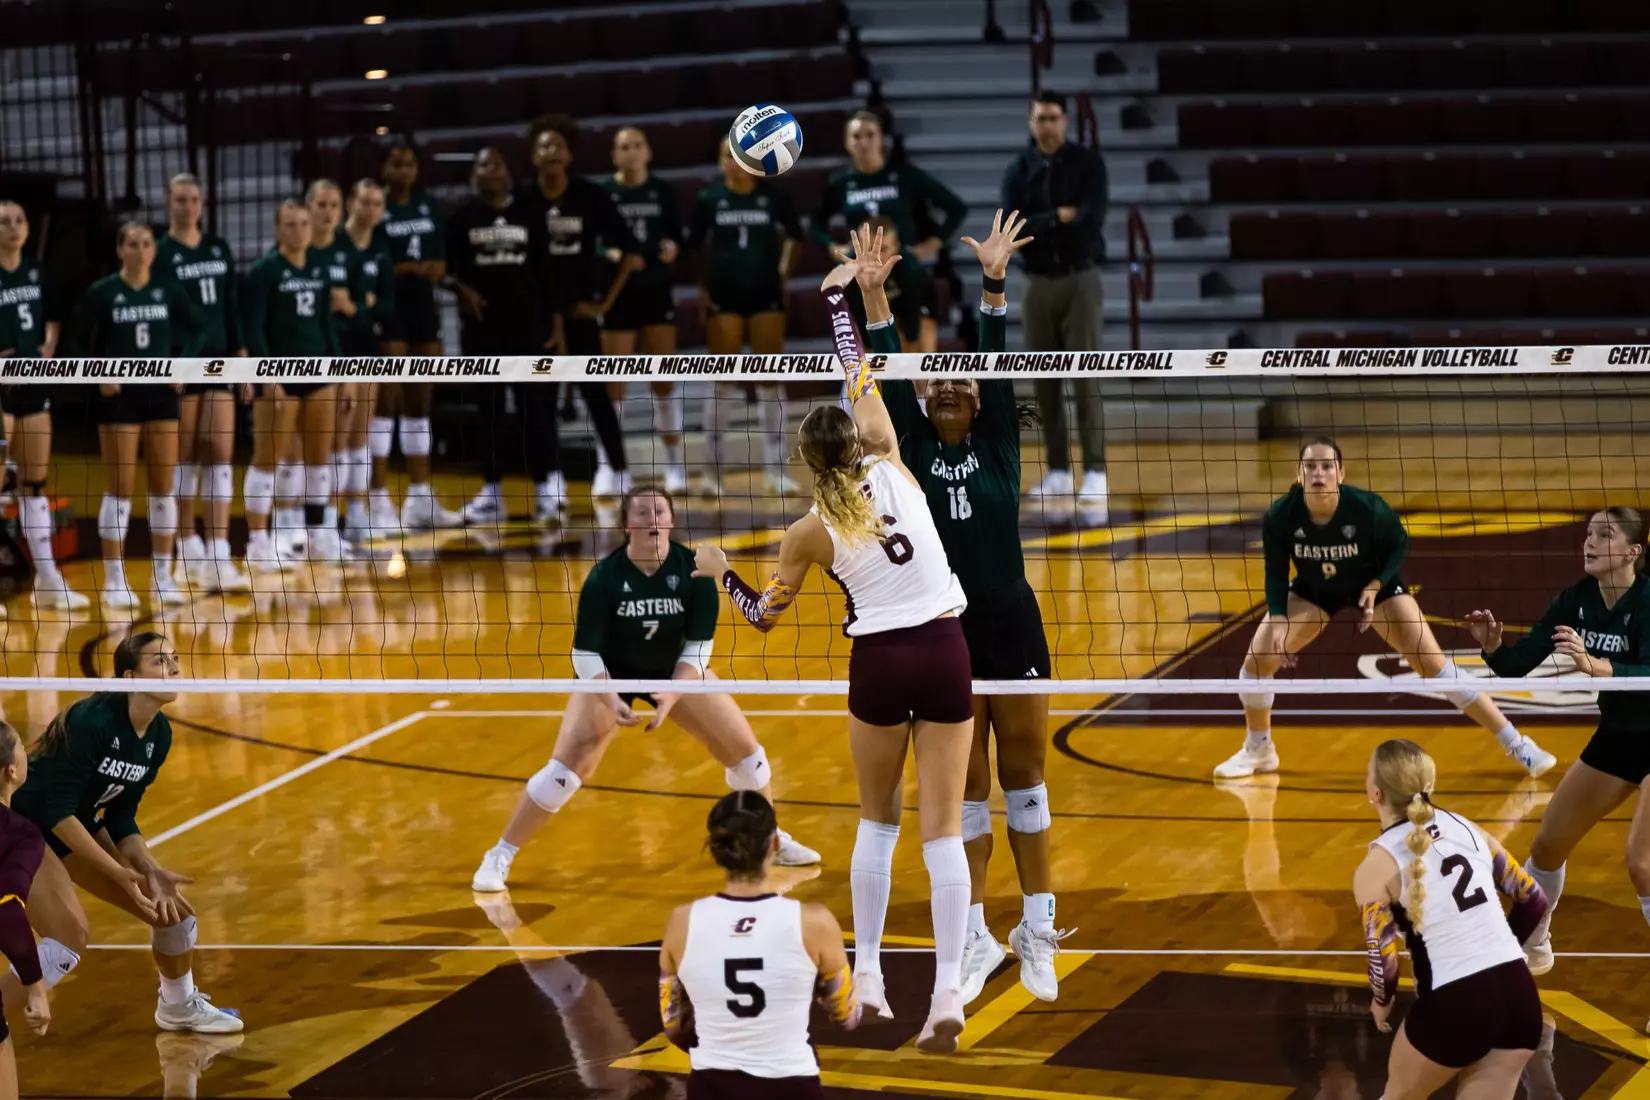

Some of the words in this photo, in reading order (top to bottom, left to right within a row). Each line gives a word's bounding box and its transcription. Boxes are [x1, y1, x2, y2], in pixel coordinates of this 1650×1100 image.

[741, 108, 776, 134] molten
[199, 277, 217, 304] 11
[112, 304, 168, 324] EASTERN
[295, 291, 316, 317] 12
[17, 303, 34, 331] 5
[135, 322, 150, 349] 6
[585, 358, 653, 375] CENTRAL
[658, 357, 736, 375] MICHIGAN
[740, 356, 834, 373] VOLLEYBALL
[920, 354, 989, 372] CENTRAL
[995, 353, 1073, 371] MICHIGAN
[1077, 352, 1173, 370] VOLLEYBALL
[1260, 350, 1331, 367] CENTRAL
[1336, 349, 1417, 367] MICHIGAN
[1421, 348, 1518, 366] VOLLEYBALL
[1607, 347, 1650, 364] CENT
[2, 360, 79, 377] MICHIGAN
[82, 360, 173, 377] VOLLEYBALL
[256, 359, 322, 376] CENTRAL
[327, 358, 405, 376] MICHIGAN
[408, 358, 500, 376] VOLLEYBALL
[947, 486, 972, 520] 18
[878, 514, 914, 566] 6
[1294, 543, 1359, 560] EASTERN
[1321, 562, 1337, 580] 9
[616, 598, 684, 617] EASTERN
[642, 620, 659, 640] 7
[97, 757, 150, 782] EASTERN
[1440, 854, 1488, 912] 2
[724, 958, 767, 1018] 5
